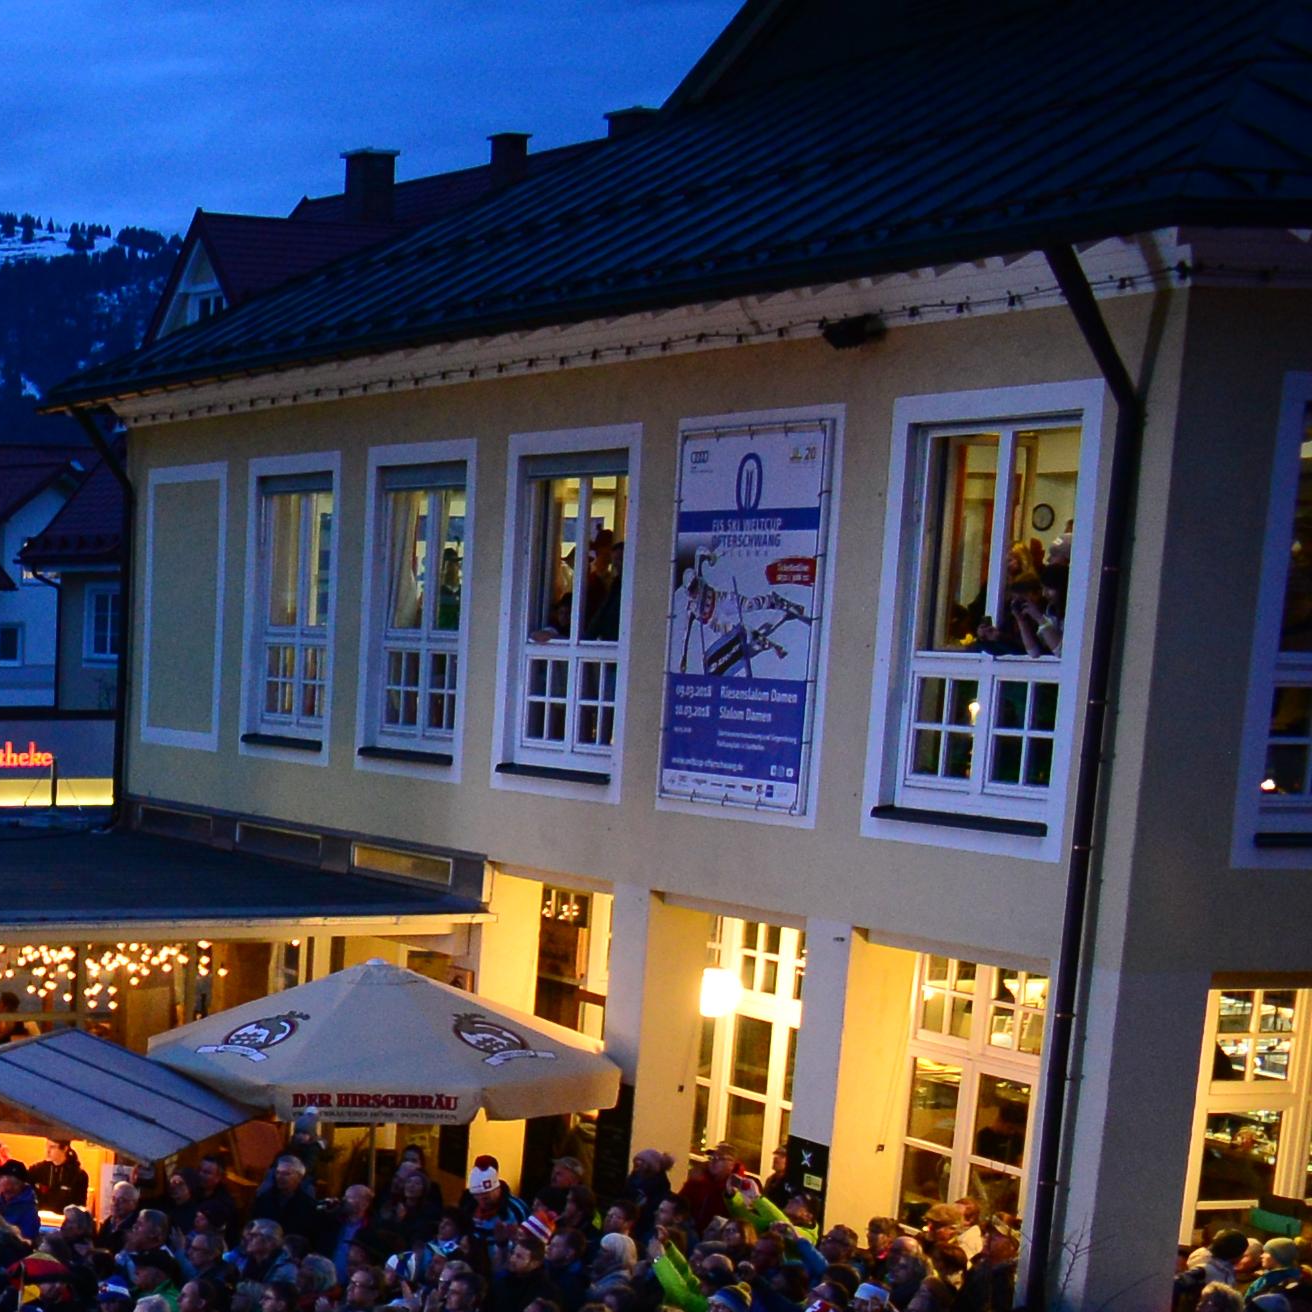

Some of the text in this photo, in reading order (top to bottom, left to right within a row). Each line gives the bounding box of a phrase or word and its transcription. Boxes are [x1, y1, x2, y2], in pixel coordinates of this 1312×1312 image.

[742, 517, 782, 531] WELTCUP
[711, 533, 781, 548] OFTERSCHWANG
[720, 685, 770, 702] Riesenslalom
[770, 688, 798, 704] Damen
[719, 705, 745, 721] Slalom
[745, 707, 772, 723] Damen
[292, 1093, 459, 1111] DER HIRSCHBRÄU
